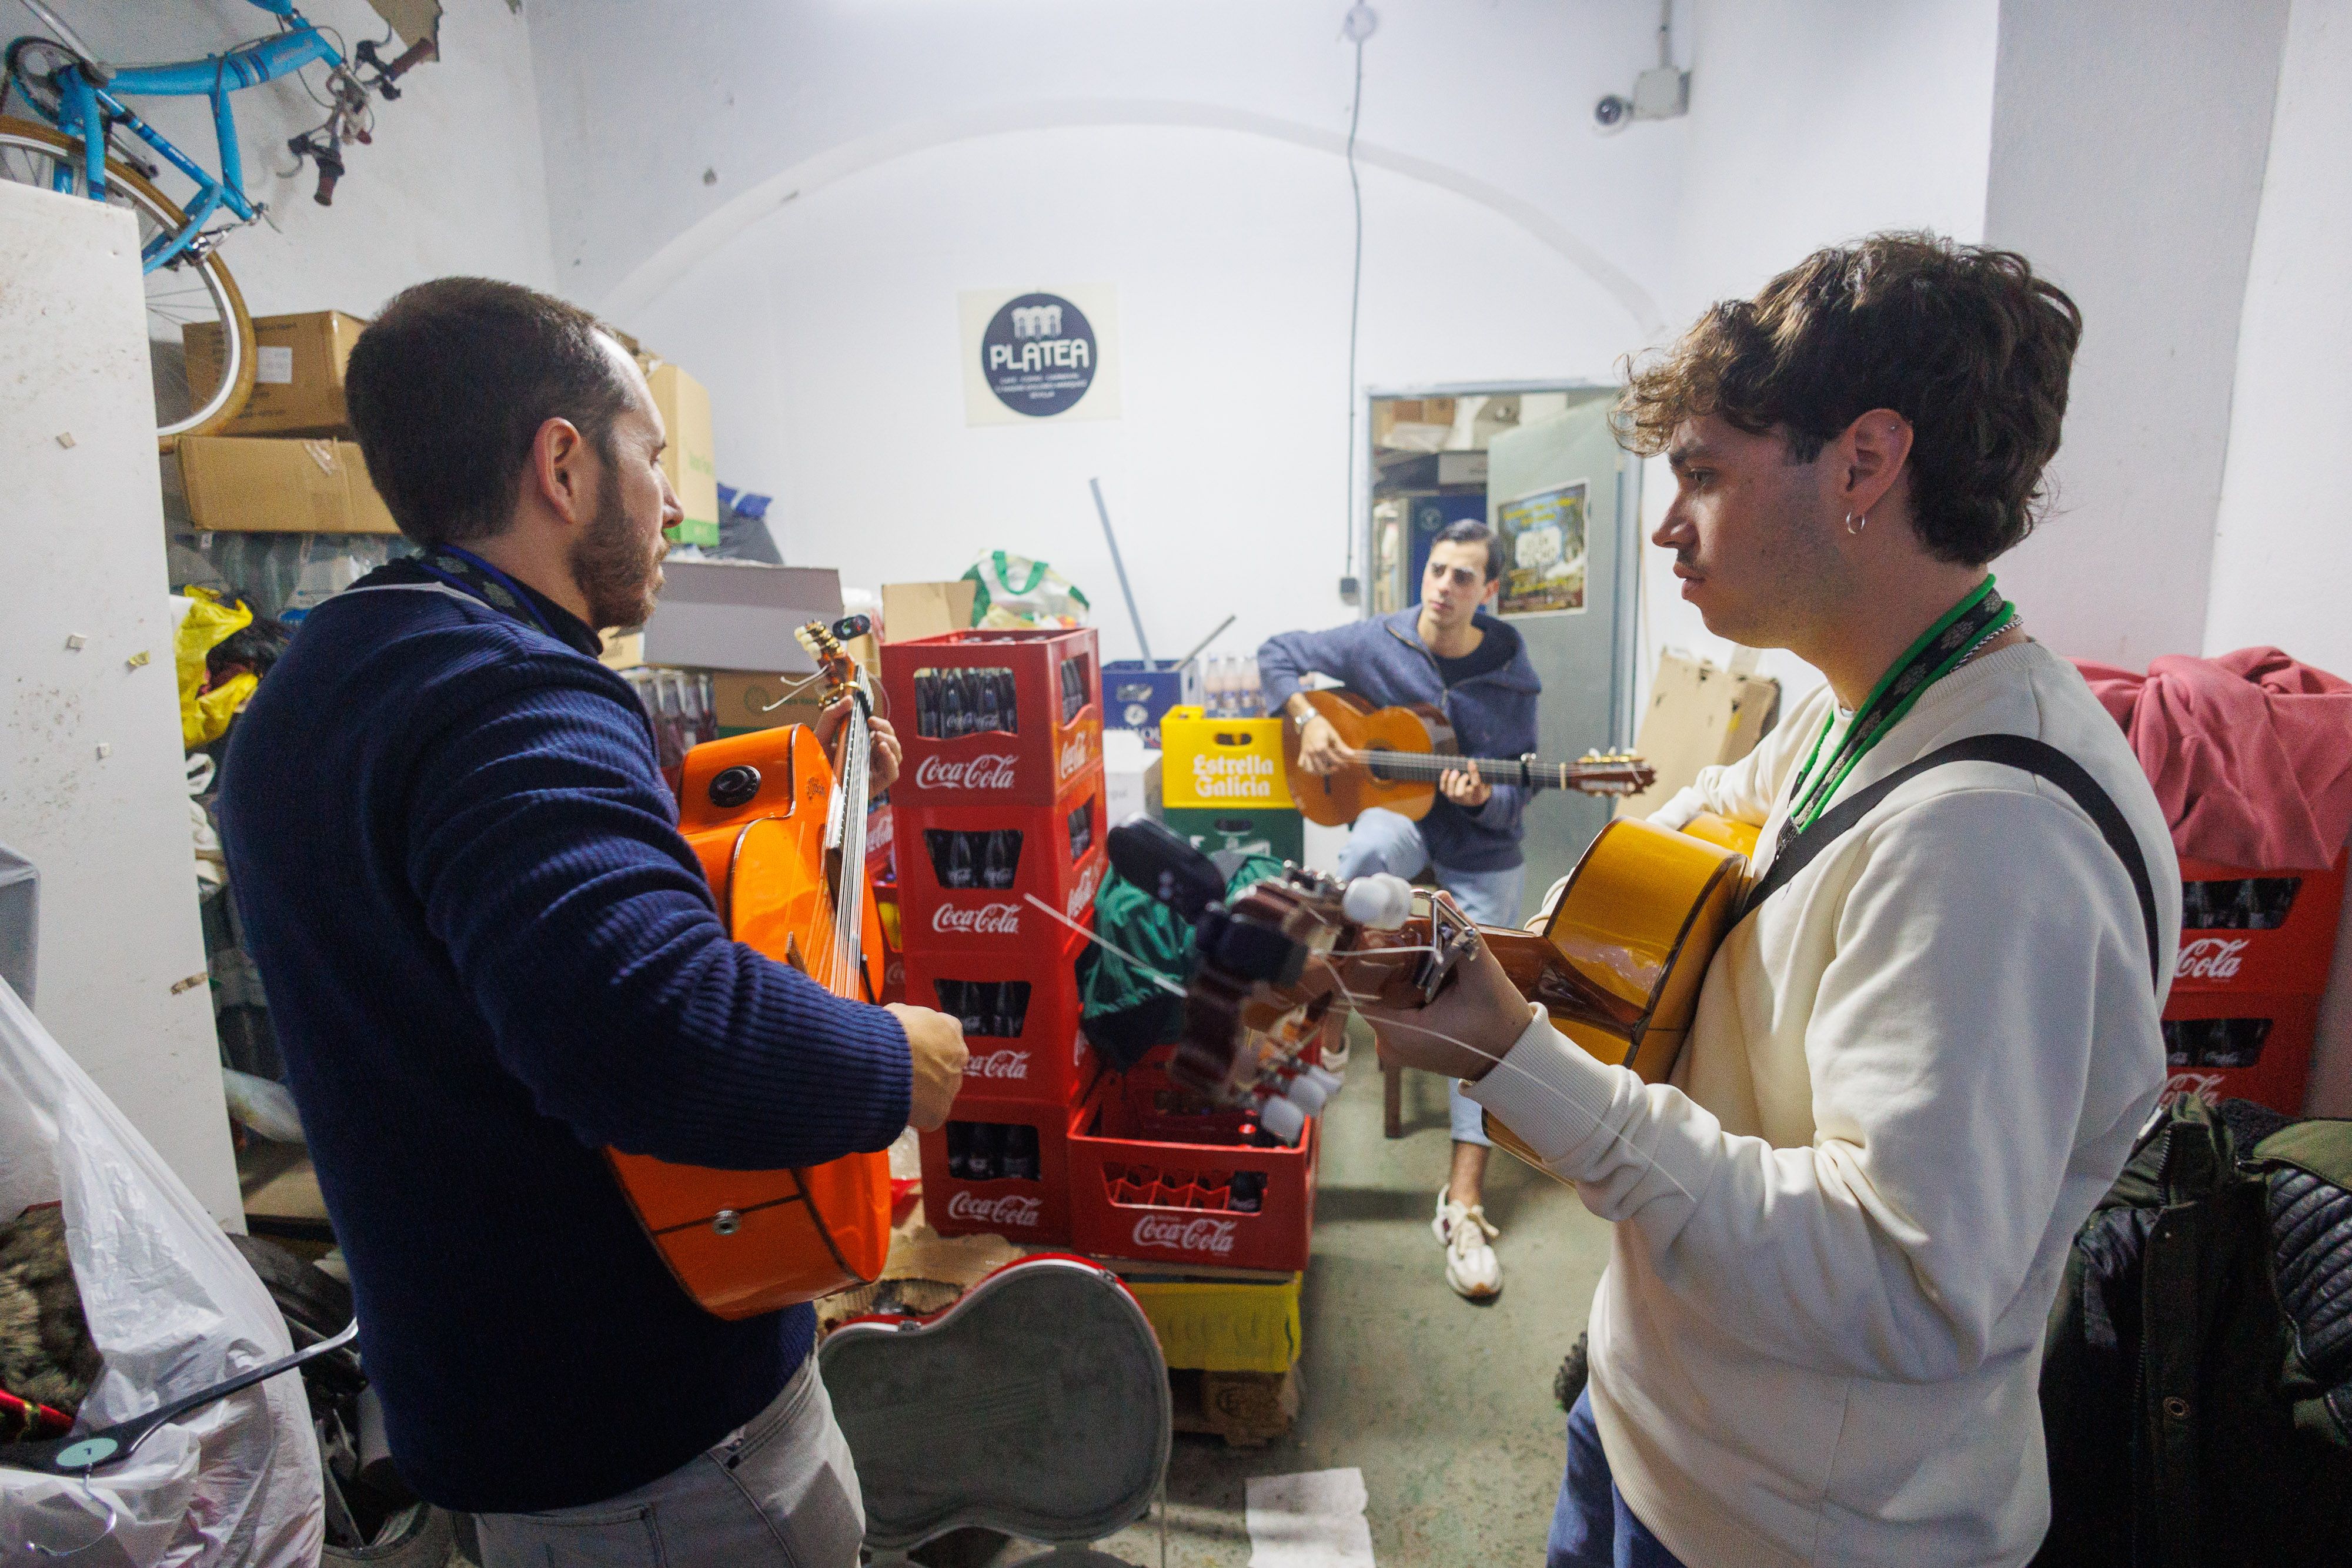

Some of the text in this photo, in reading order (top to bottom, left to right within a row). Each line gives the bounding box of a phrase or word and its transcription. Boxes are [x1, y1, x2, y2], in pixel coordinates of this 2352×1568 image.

[990, 338, 1090, 372] PLATEA
[1192, 754, 1274, 775] Estrella
[1195, 775, 1271, 797] Galicia
